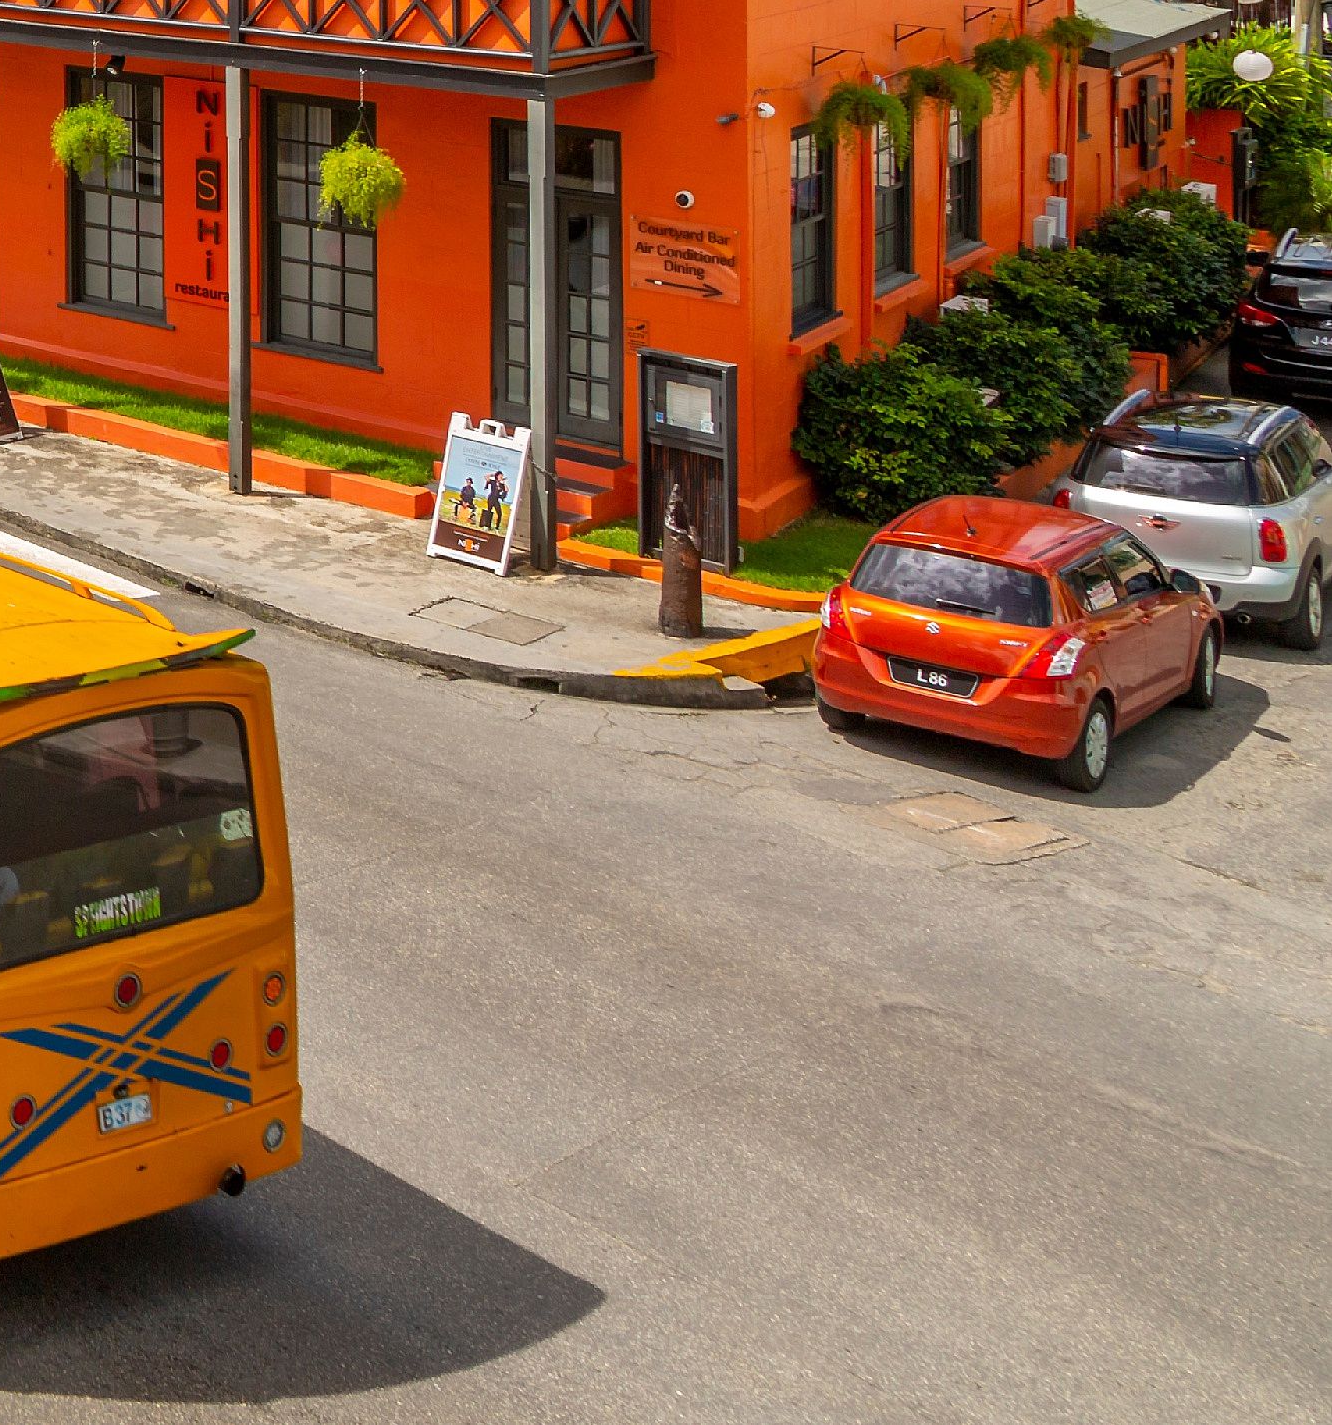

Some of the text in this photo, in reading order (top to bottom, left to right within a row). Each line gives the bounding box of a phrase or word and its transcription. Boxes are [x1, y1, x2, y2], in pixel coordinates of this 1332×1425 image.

[638, 221, 730, 246] Courtyard Bar
[635, 241, 736, 268] Air Conditioned
[664, 260, 705, 281] Dining
[174, 282, 229, 303] restaura
[917, 668, 947, 688] L86
